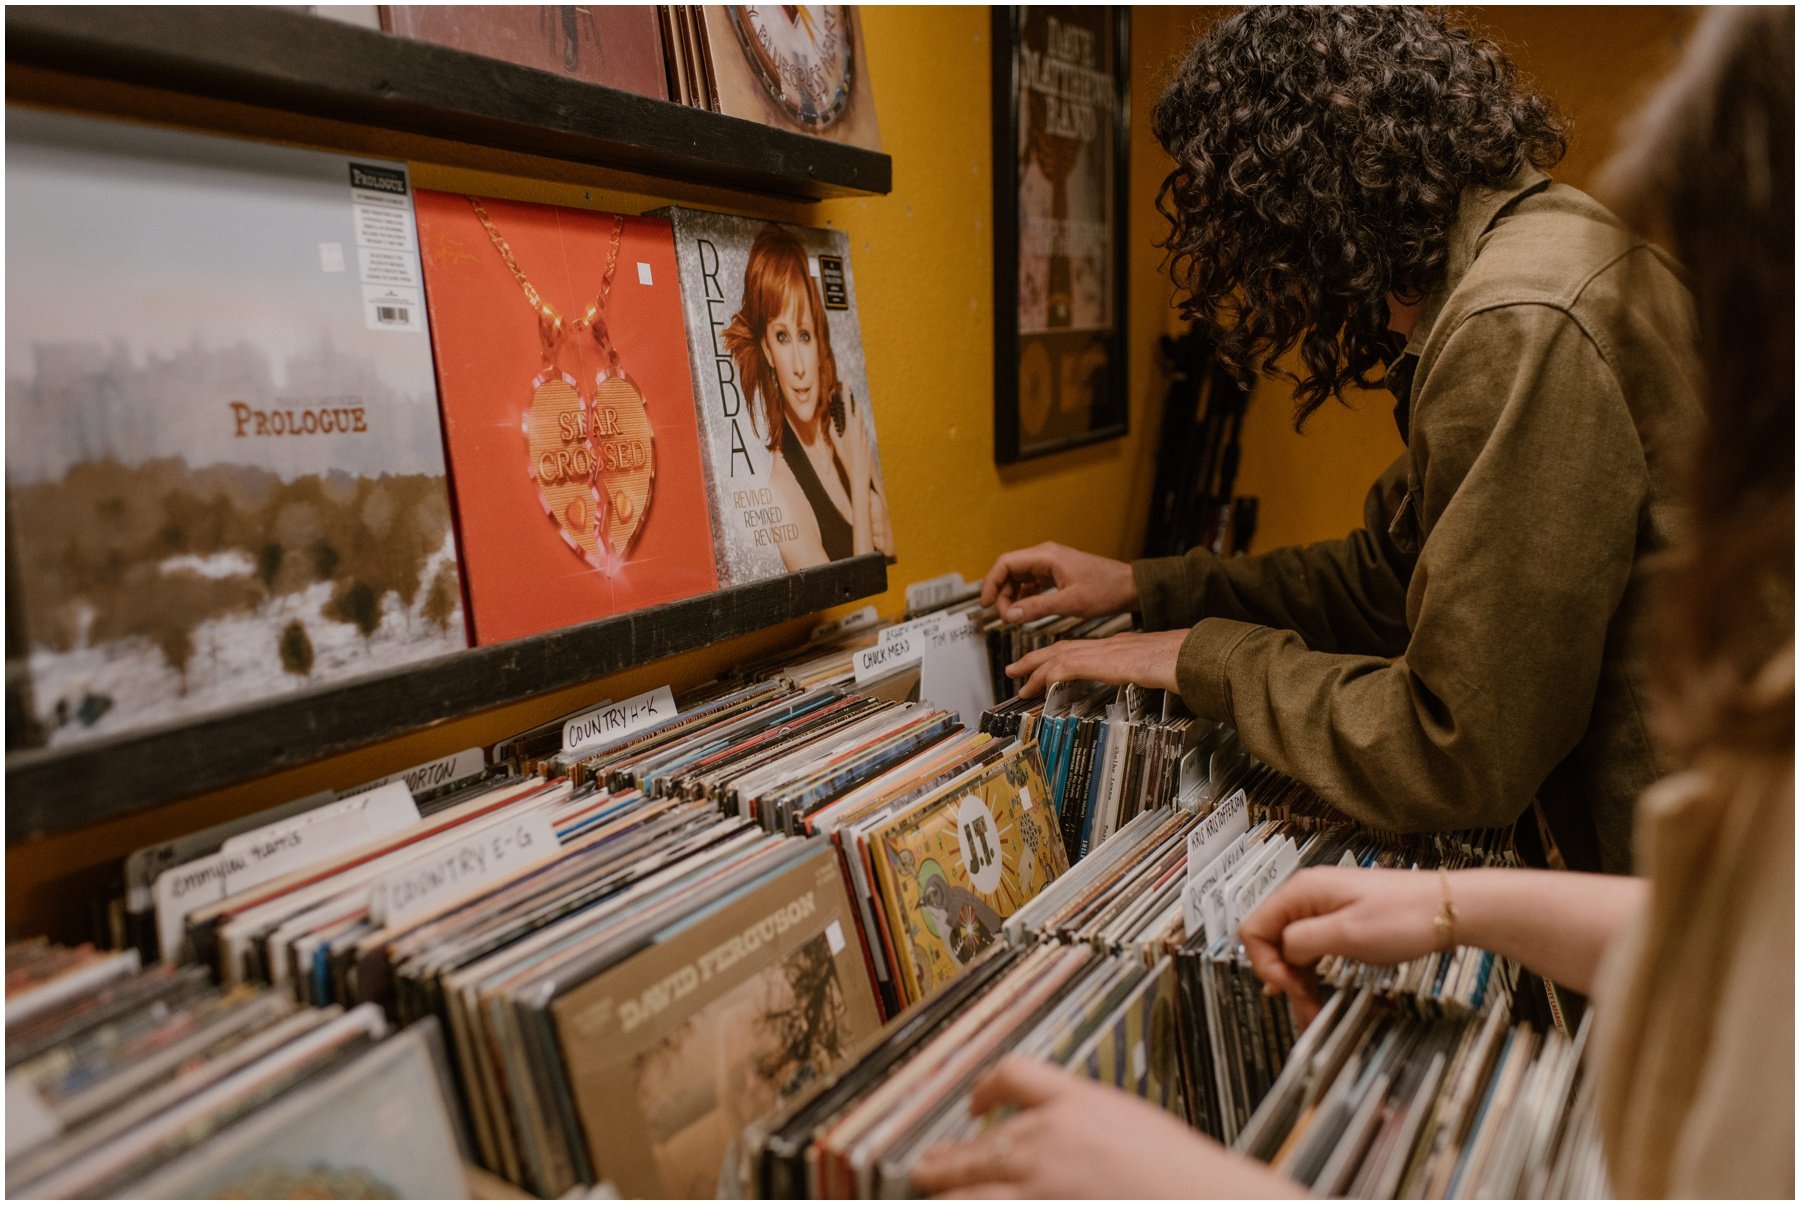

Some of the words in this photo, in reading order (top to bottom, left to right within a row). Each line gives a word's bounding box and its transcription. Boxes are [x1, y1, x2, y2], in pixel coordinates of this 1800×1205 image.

[1045, 96, 1096, 142] BAND
[697, 238, 755, 477] REBA
[559, 408, 623, 441] STAR
[539, 441, 646, 481] CROSSED
[733, 488, 773, 509] REVIVED
[744, 506, 782, 528] REMIXED
[754, 524, 799, 547] REVISITED
[863, 649, 886, 669] CHUCK
[888, 639, 911, 660] MEAD
[569, 706, 627, 748] COUNTRY
[630, 695, 658, 722] H-K
[963, 815, 995, 875] J.T.
[1191, 828, 1205, 851] KRIS
[1206, 793, 1245, 839] KRISTOFFERSON
[391, 846, 487, 910] COUNTRY
[491, 825, 533, 860] E-G
[617, 964, 700, 1032] DAVID
[697, 891, 817, 984] FERGUSON
